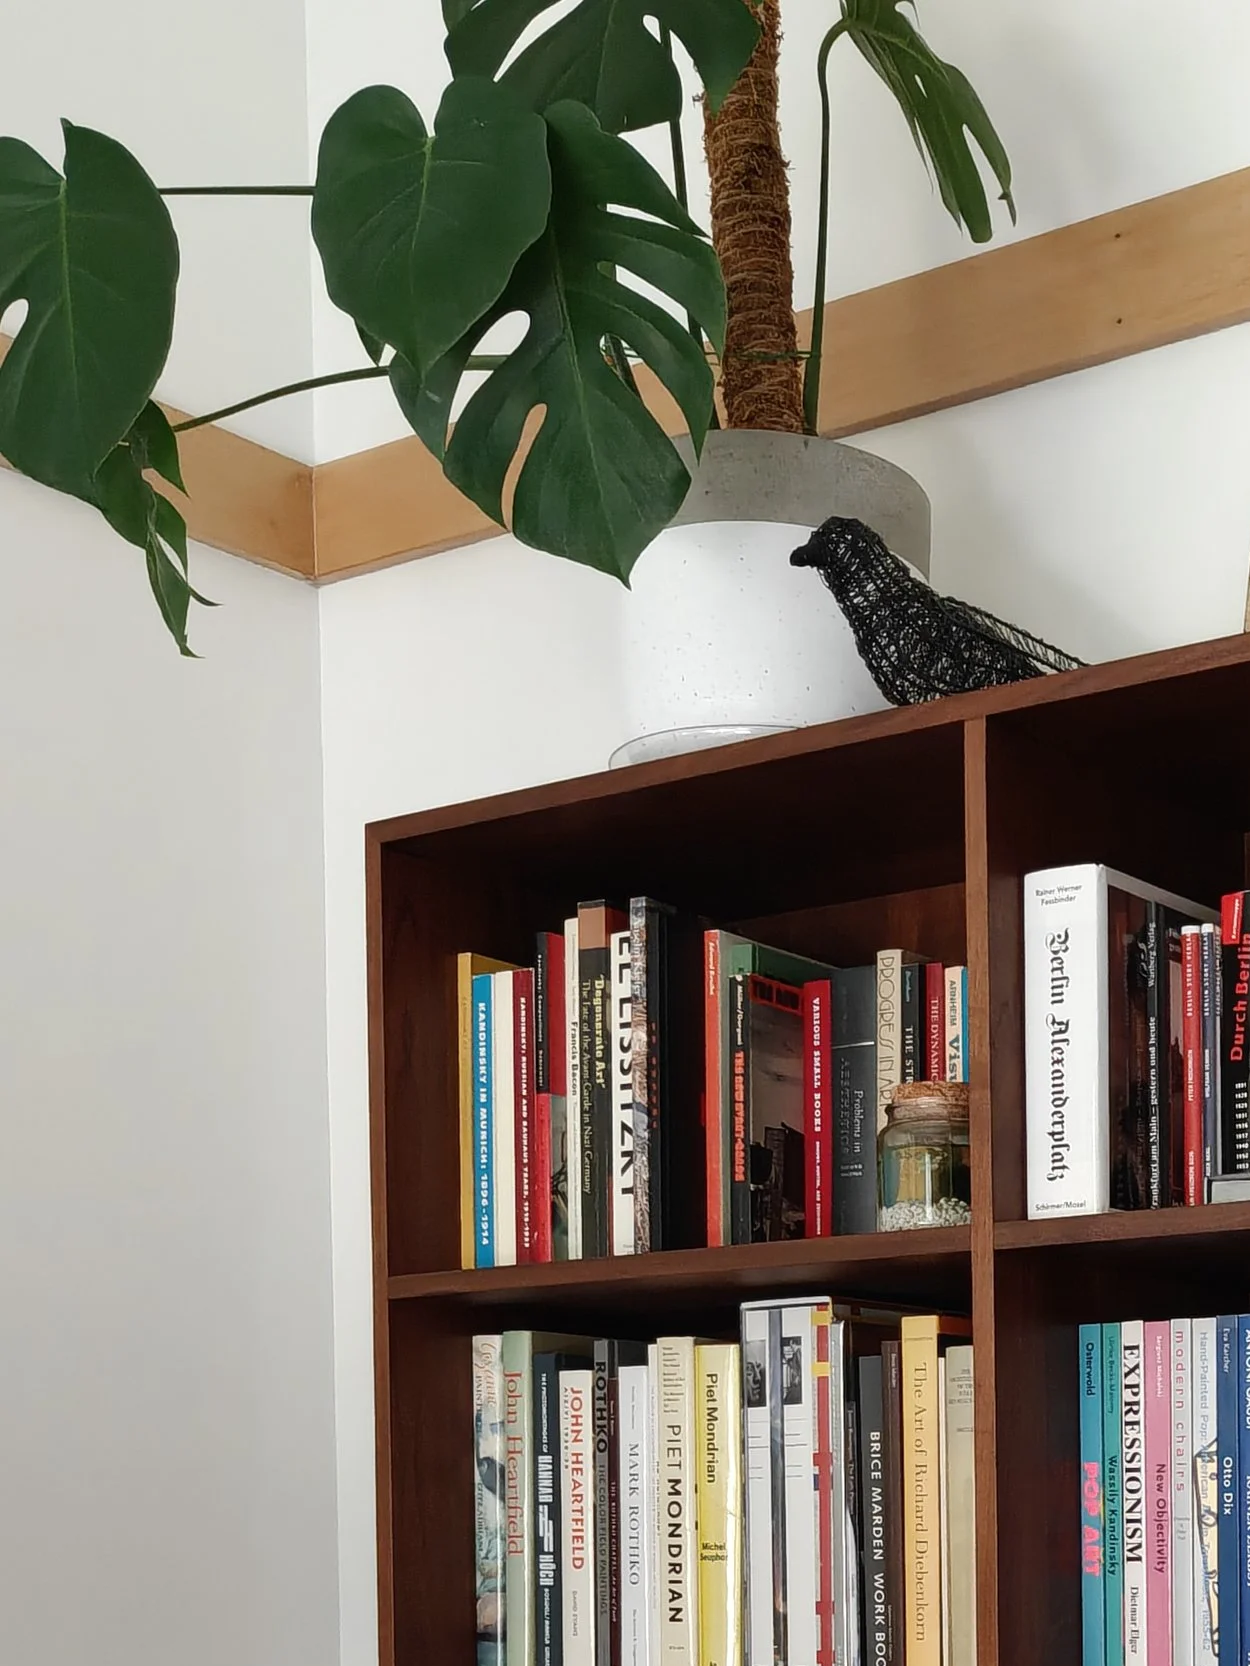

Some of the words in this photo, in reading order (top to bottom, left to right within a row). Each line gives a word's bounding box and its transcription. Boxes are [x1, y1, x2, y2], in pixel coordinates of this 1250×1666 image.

[813, 997, 821, 1046] VARIOUS
[879, 957, 896, 1050] PROGRESS
[931, 998, 939, 1022] THE
[1230, 997, 1247, 1061] Durch
[478, 1003, 489, 1084] KANDINSKY
[570, 1022, 578, 1060] Francis
[905, 1026, 914, 1053] THE
[813, 1051, 821, 1088] SMALL
[813, 1093, 821, 1132] BOOKS
[1045, 1013, 1070, 1182] Alexanderplatz
[854, 1141, 863, 1152] in
[706, 1373, 719, 1404] Piet
[913, 1362, 928, 1398] The
[1085, 1342, 1097, 1396] Osterwold
[1175, 1330, 1186, 1409] modern
[504, 1370, 524, 1423] John
[571, 1387, 584, 1445] JOHN
[595, 1361, 608, 1453] ROTHKO
[913, 1404, 928, 1431] Art
[629, 1443, 640, 1495] MARK
[667, 1425, 681, 1470] PIET
[706, 1407, 720, 1483] Mondrian
[870, 1432, 882, 1479] BRICE
[914, 1438, 928, 1455] of
[1123, 1344, 1142, 1564] EXPRESSIONISM
[507, 1436, 525, 1556] Heartfield
[914, 1464, 929, 1531] Richard
[1084, 1462, 1100, 1517] POP
[1107, 1456, 1118, 1504] Wassily
[1155, 1464, 1167, 1493] New
[1223, 1457, 1234, 1488] Otto
[571, 1453, 585, 1570] HEARTFIELD
[872, 1487, 884, 1559] MARDEN
[1223, 1492, 1234, 1515] Dix
[629, 1506, 640, 1585] ROTHKO
[667, 1479, 683, 1622] MONDRIAN
[1107, 1509, 1118, 1575] Kandinsky
[1153, 1498, 1168, 1573] Objectivity
[600, 1560, 608, 1615] PAINTINGS
[873, 1573, 886, 1625] WORK
[914, 1539, 929, 1641] Diebenkorn
[1130, 1587, 1140, 1626] Dietmar
